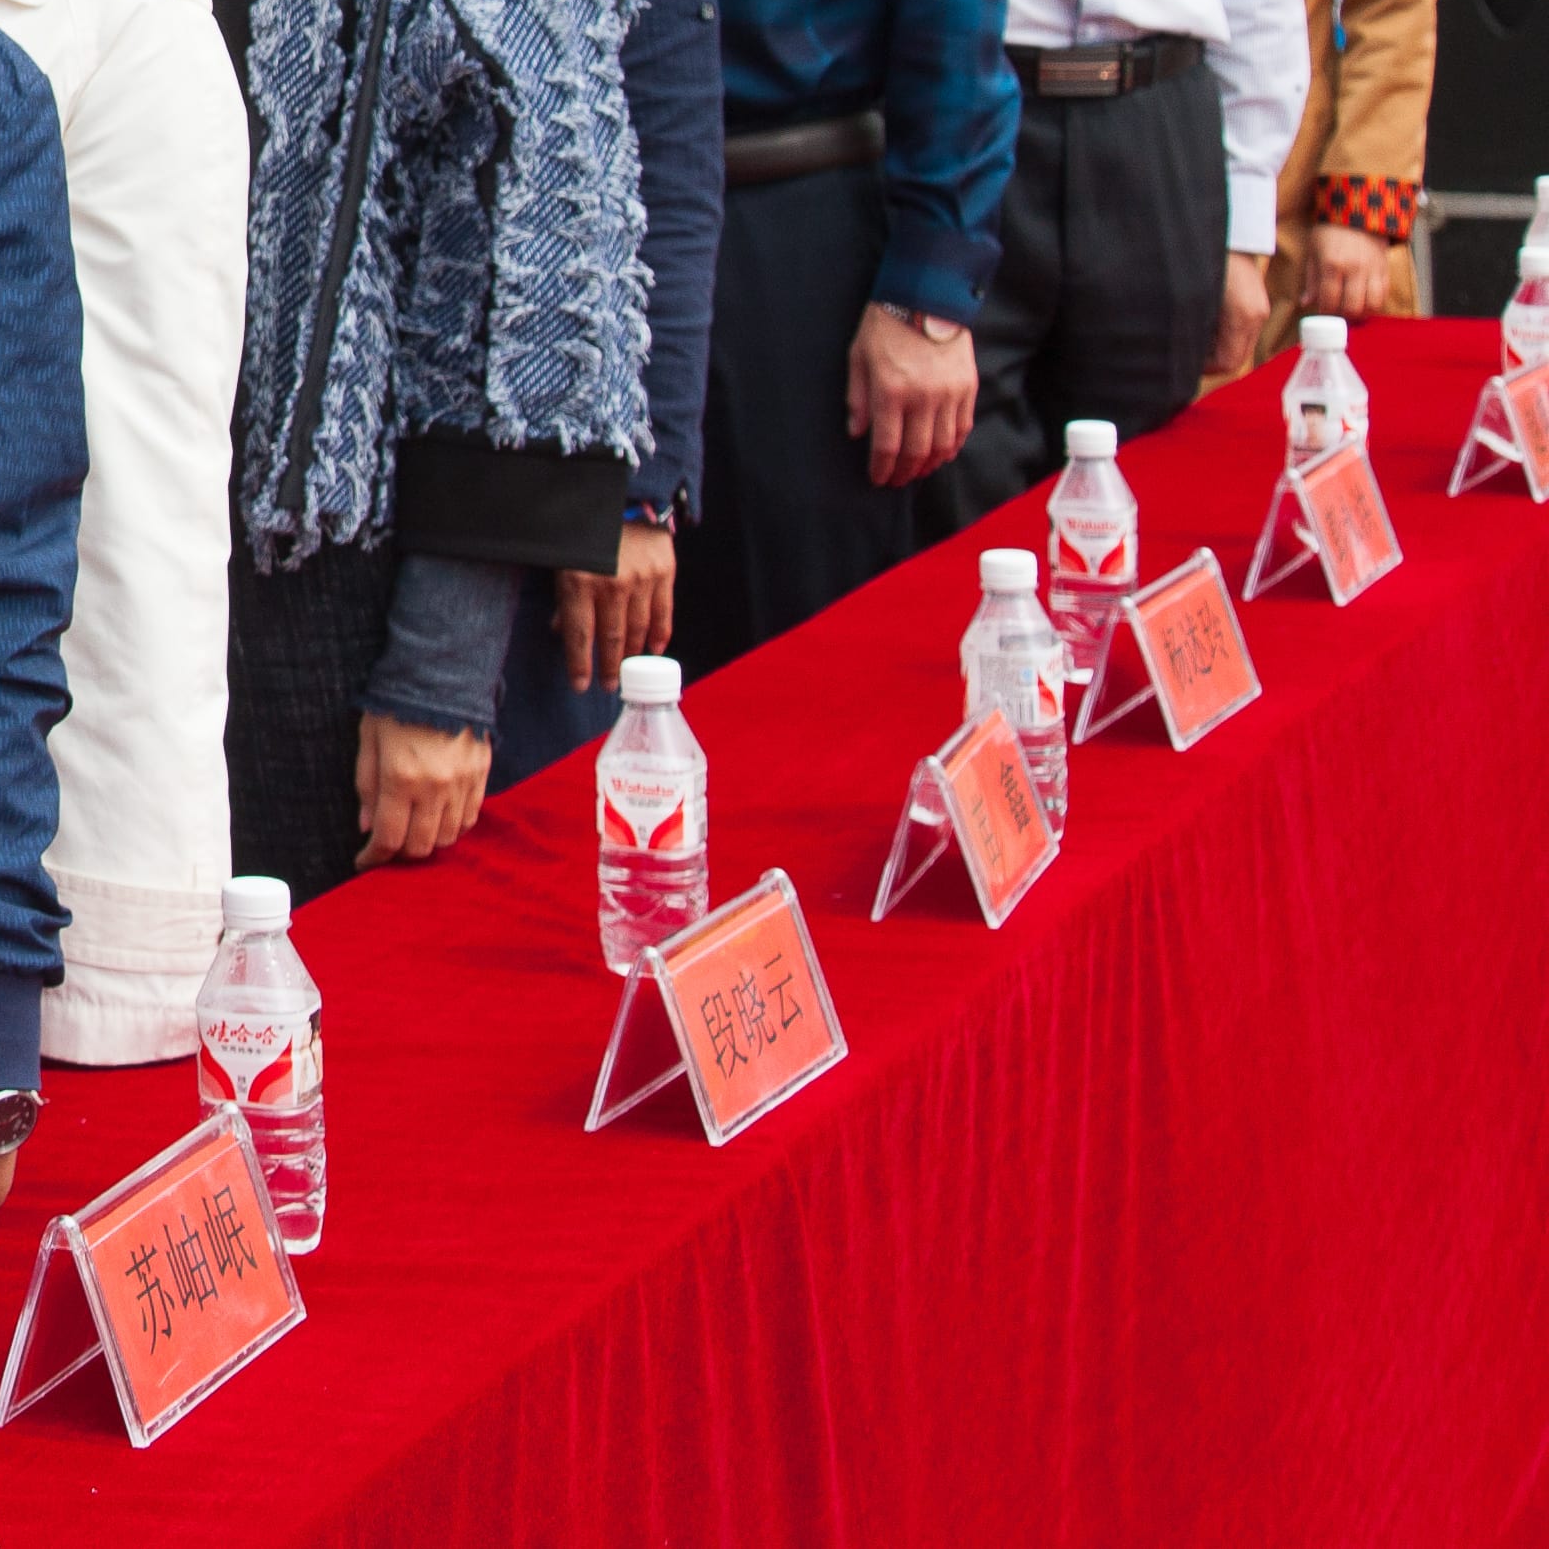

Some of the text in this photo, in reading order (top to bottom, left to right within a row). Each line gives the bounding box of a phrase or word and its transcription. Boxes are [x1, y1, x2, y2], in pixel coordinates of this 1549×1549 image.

[207, 1020, 277, 1045] 娃哈哈
[701, 953, 803, 1079] 段晓云
[125, 1184, 258, 1355] 苏岫岷
